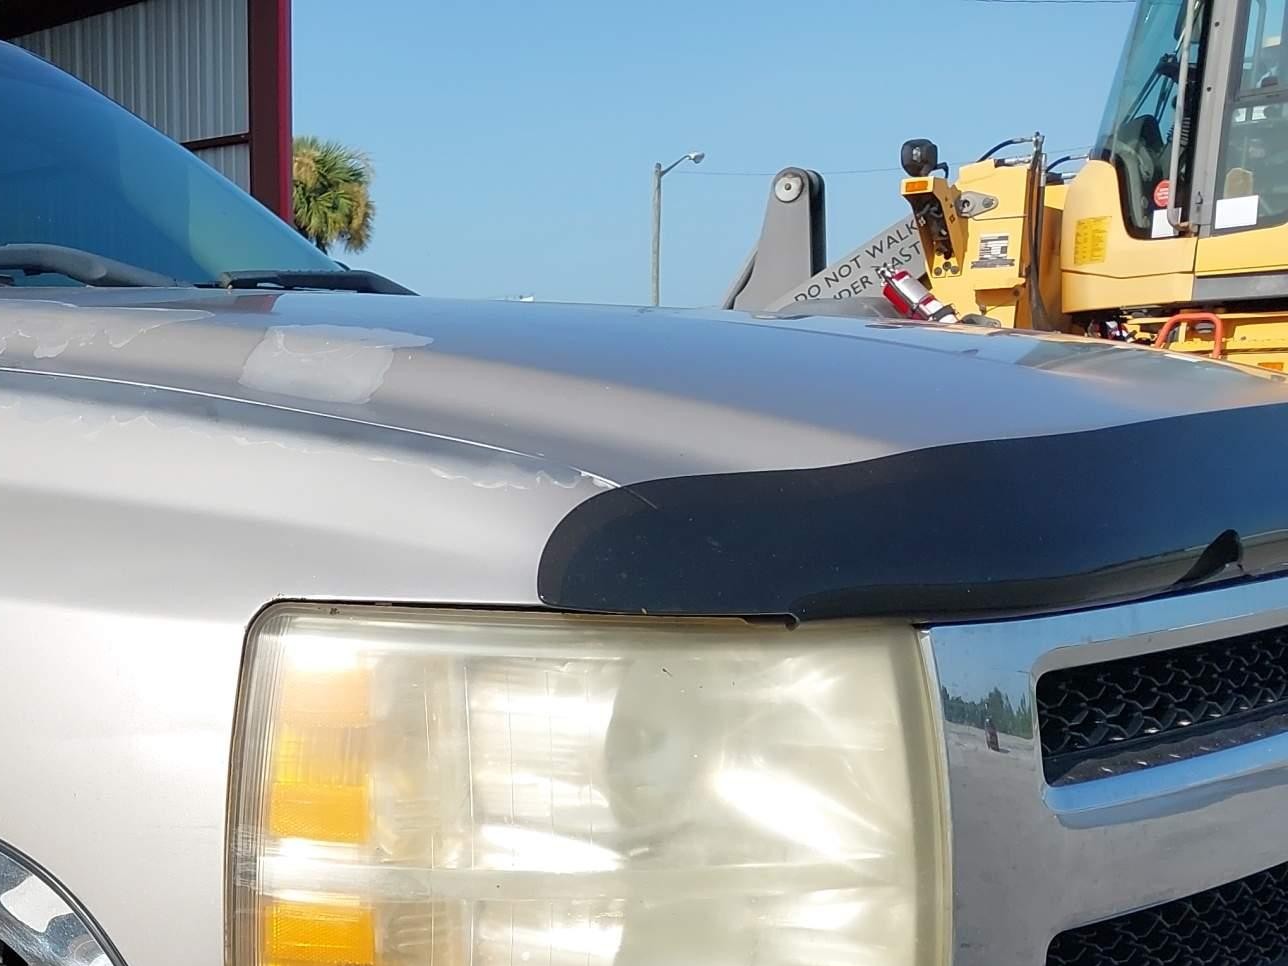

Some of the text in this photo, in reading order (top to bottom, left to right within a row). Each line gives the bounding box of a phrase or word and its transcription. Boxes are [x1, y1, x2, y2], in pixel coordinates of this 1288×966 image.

[794, 219, 919, 301] DO NOT WALK
[817, 275, 873, 300] DER
